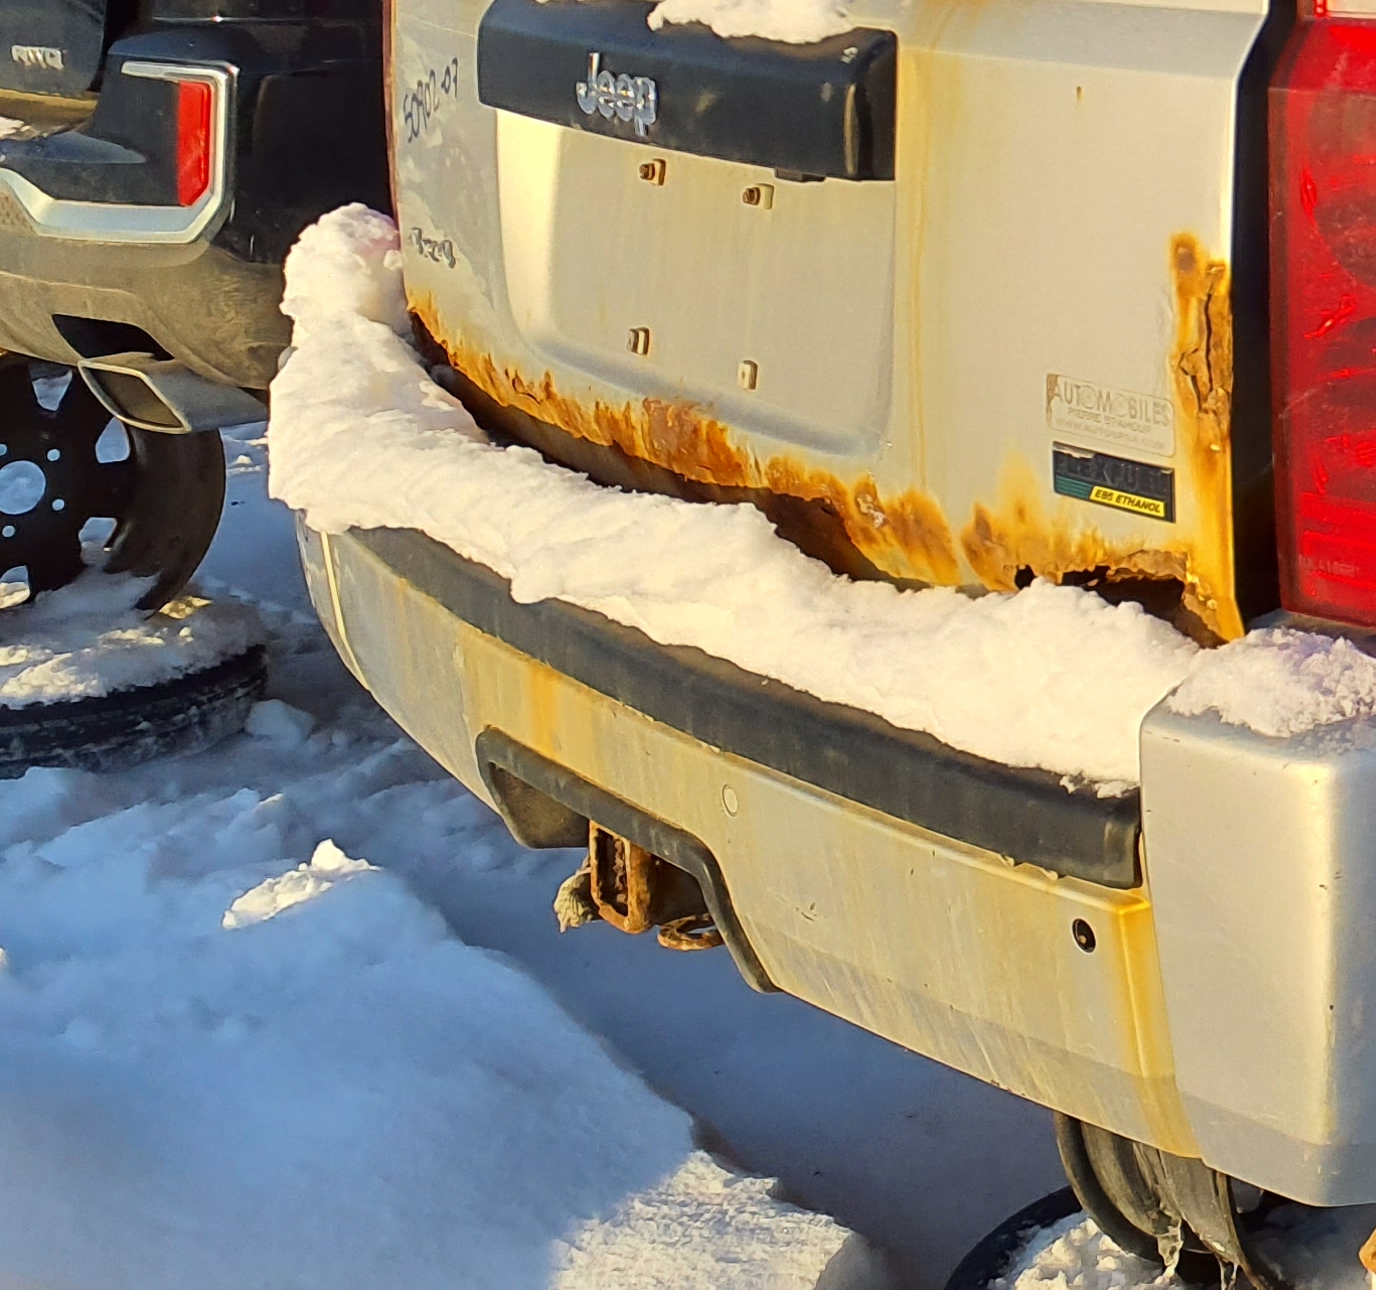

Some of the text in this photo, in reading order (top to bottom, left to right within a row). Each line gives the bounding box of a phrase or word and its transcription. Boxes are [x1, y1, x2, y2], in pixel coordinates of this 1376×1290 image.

[576, 52, 657, 137] Jeep
[1052, 381, 1170, 427] AUTOMOBILES
[1095, 489, 1161, 513] E85 ETHANOL
